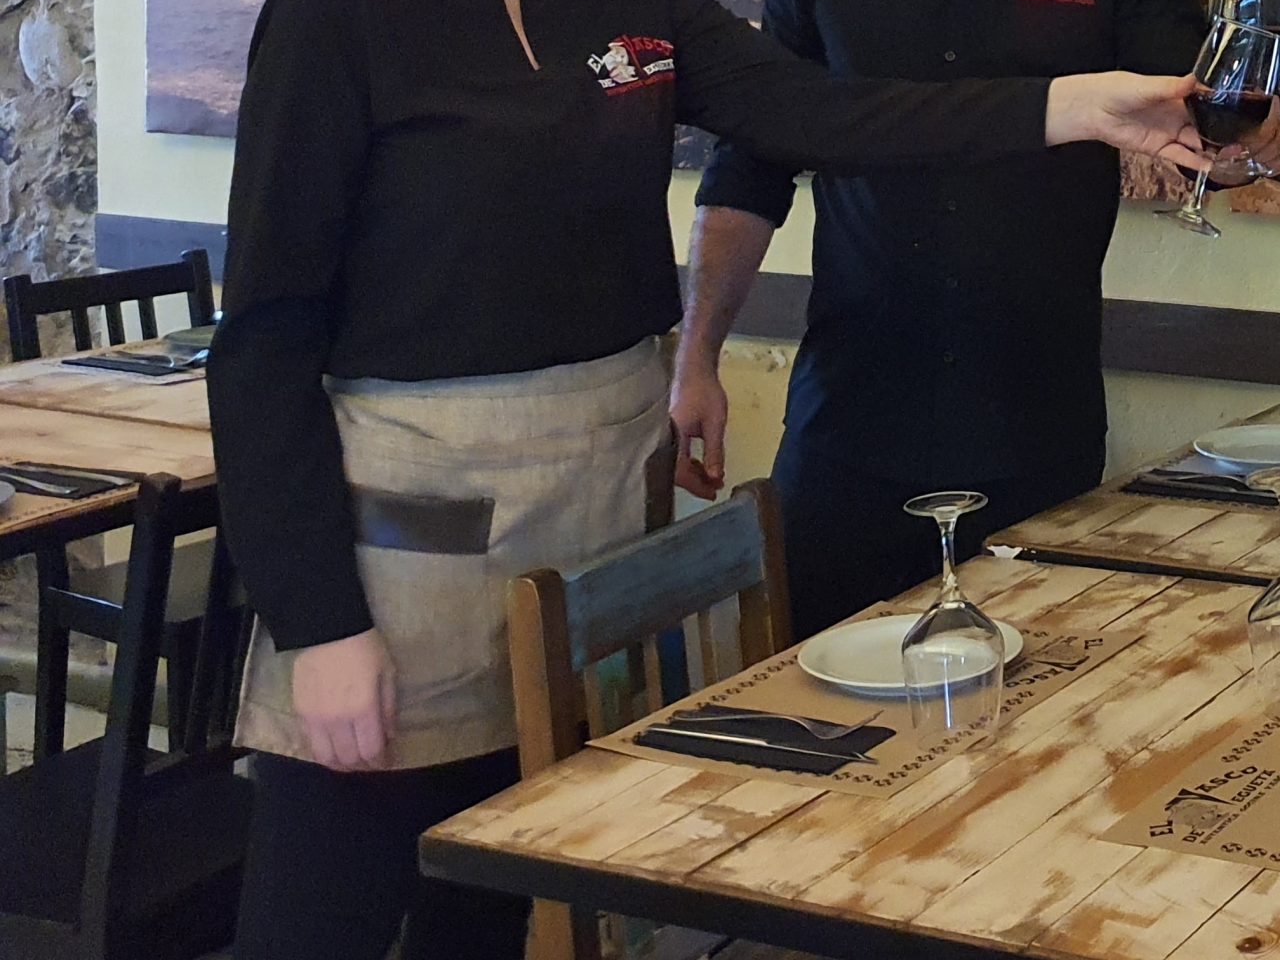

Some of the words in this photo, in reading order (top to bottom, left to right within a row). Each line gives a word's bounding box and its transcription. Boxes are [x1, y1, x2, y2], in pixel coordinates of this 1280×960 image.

[1149, 820, 1174, 837] EL
[1165, 765, 1258, 811] VASCO
[1182, 829, 1205, 843] DE
